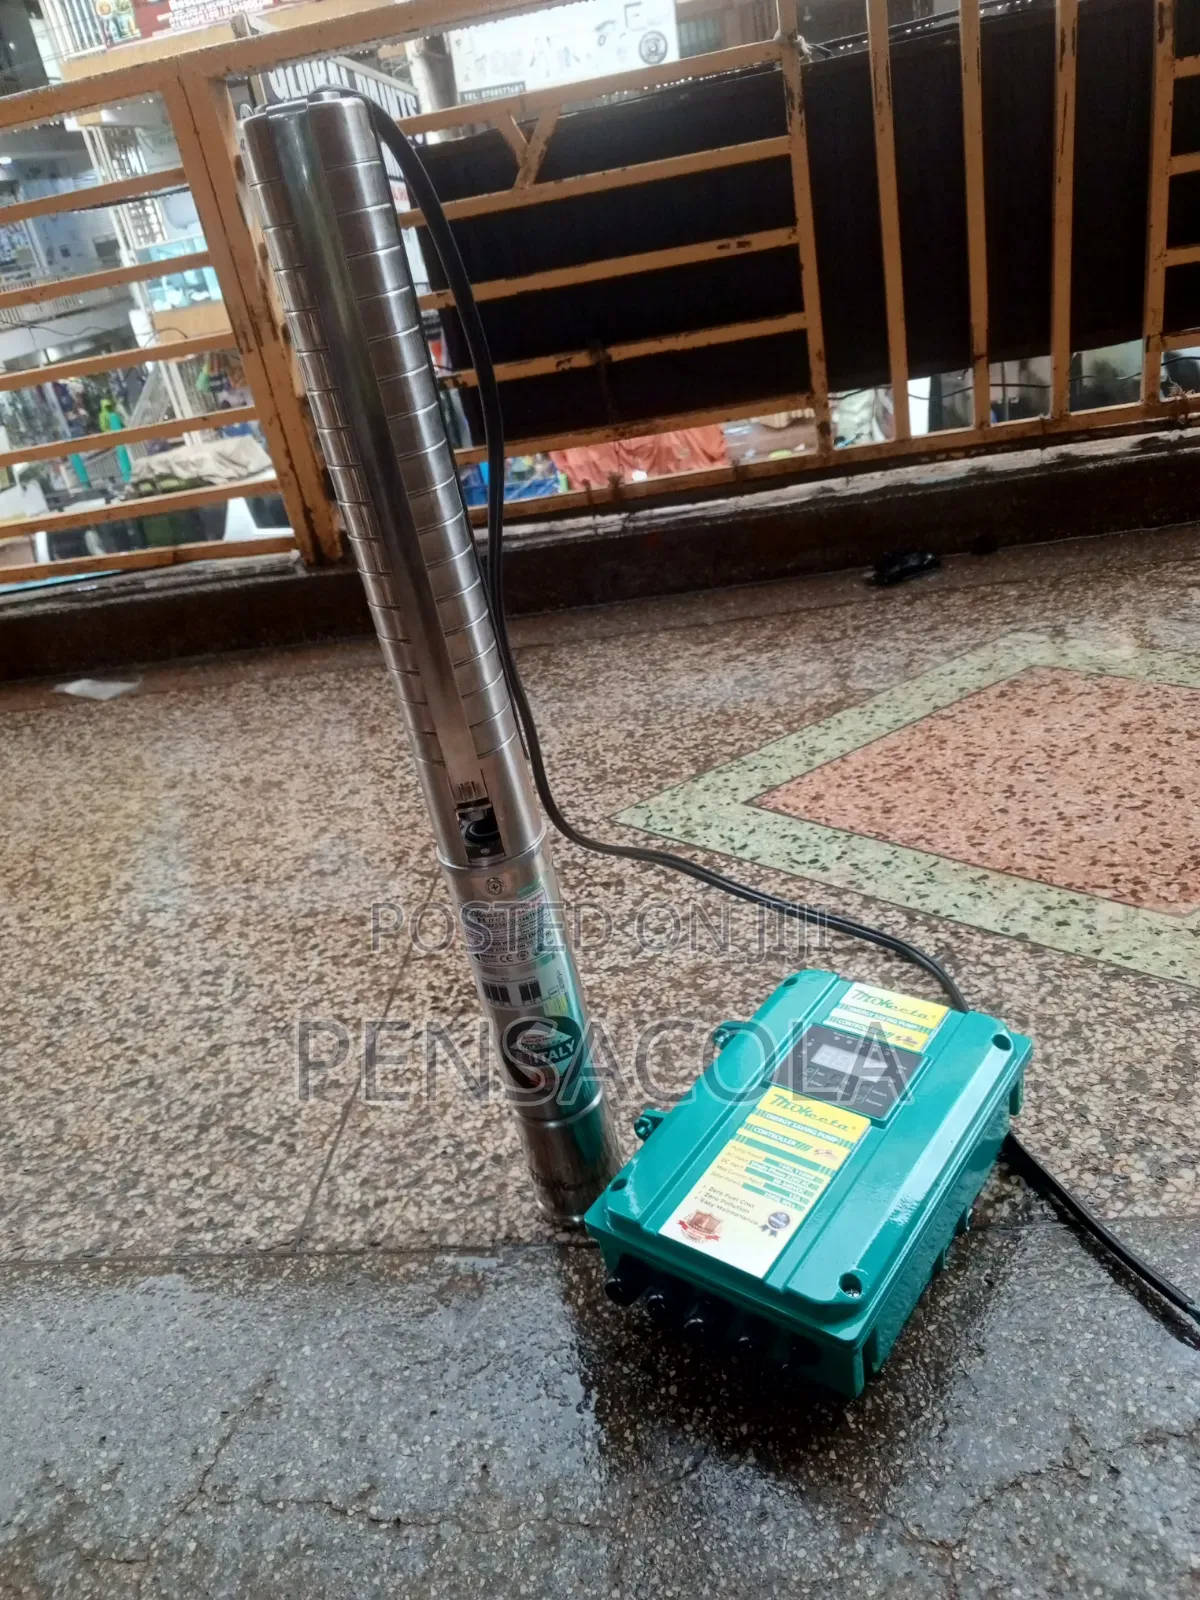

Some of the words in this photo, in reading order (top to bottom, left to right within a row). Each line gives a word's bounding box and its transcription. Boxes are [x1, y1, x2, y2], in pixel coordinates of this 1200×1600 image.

[751, 1126, 798, 1146] CONTROLLER
[764, 1113, 793, 1126] ENERGY
[790, 1122, 818, 1135] SAVING
[815, 1131, 839, 1143] PUMP
[703, 1192, 720, 1201] Zero
[718, 1198, 751, 1213] Pollution
[707, 1185, 725, 1196] Zero
[723, 1192, 740, 1202] Fuel
[738, 1199, 756, 1208] Cost
[698, 1197, 716, 1207] Easy
[713, 1204, 761, 1226] Maintenance
